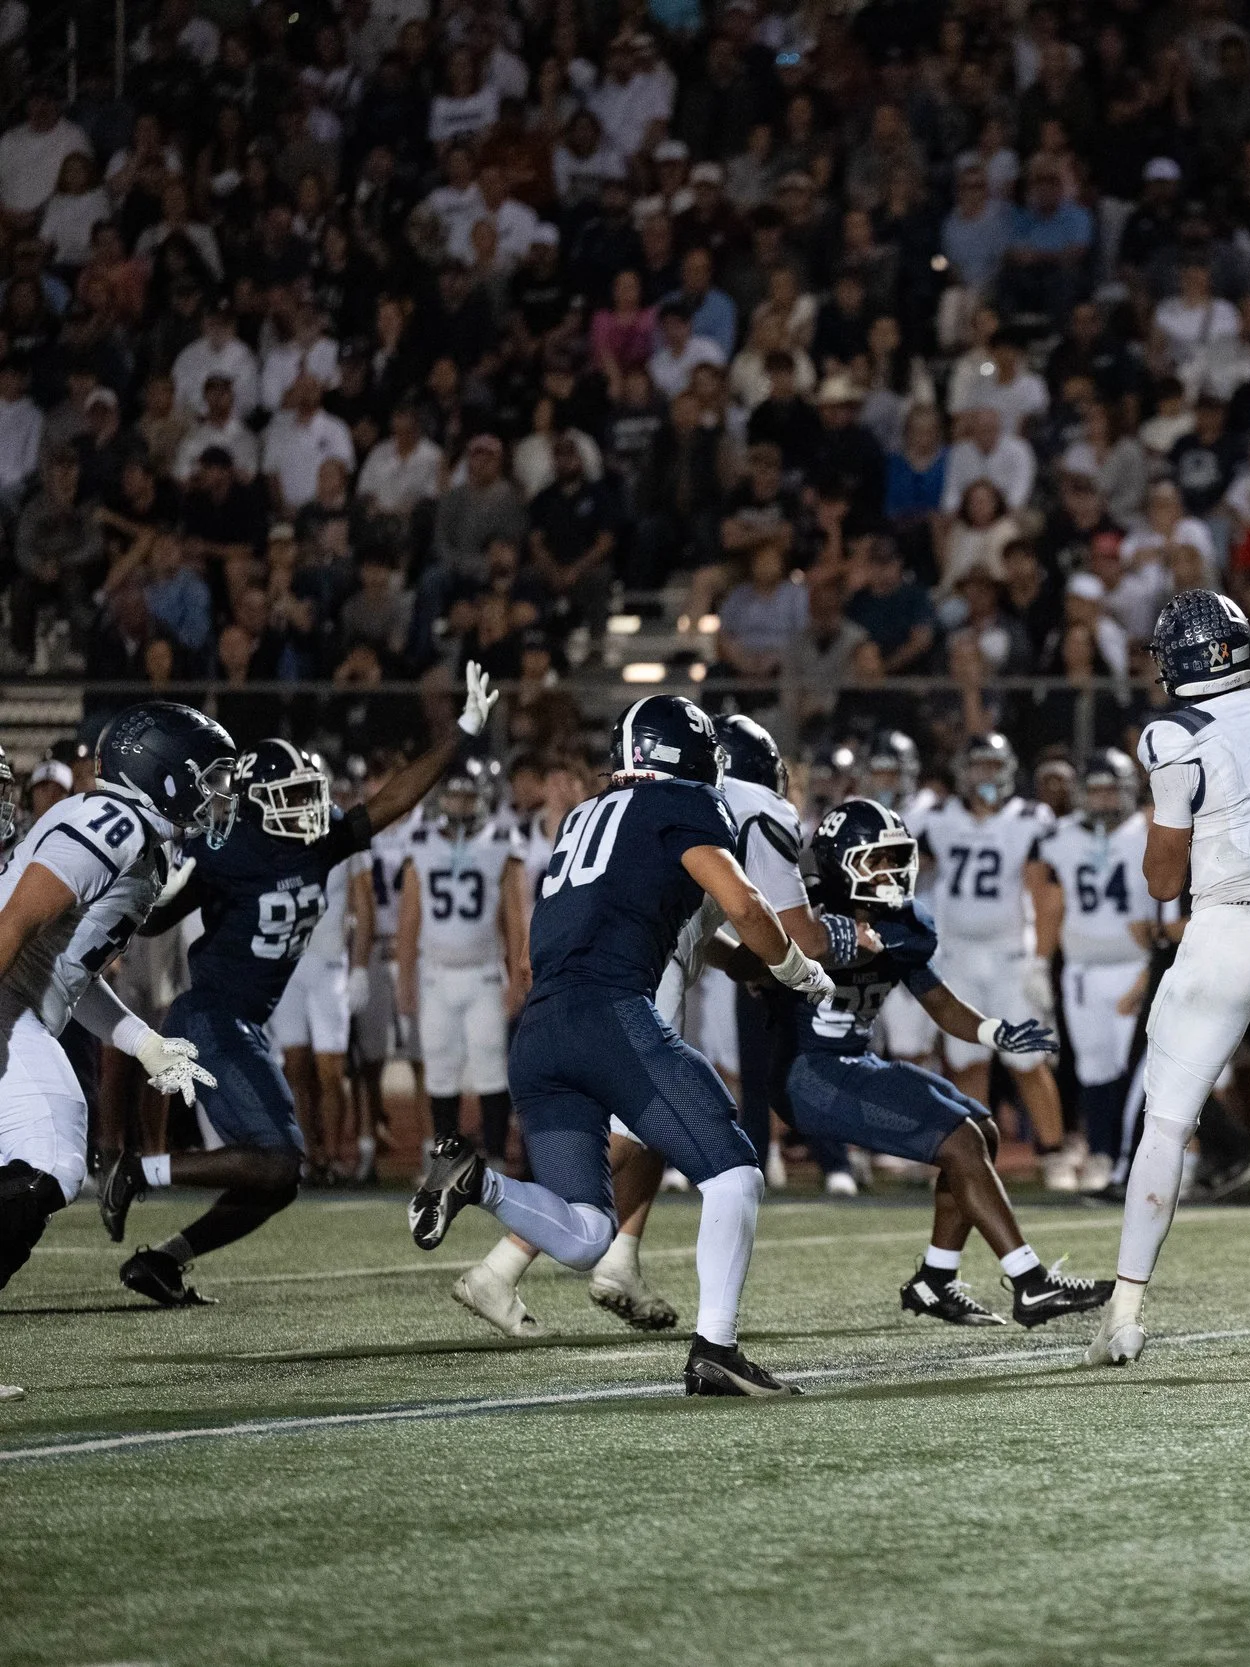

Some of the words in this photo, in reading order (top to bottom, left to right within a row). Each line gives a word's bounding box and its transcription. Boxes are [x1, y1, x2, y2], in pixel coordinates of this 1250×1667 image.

[1145, 729, 1159, 764] 1
[86, 801, 135, 849] 78
[542, 788, 634, 899] 90
[818, 811, 848, 838] 99
[429, 869, 484, 920] 53
[950, 848, 1001, 898] 72
[1077, 862, 1129, 914] 64
[250, 883, 327, 960] 92
